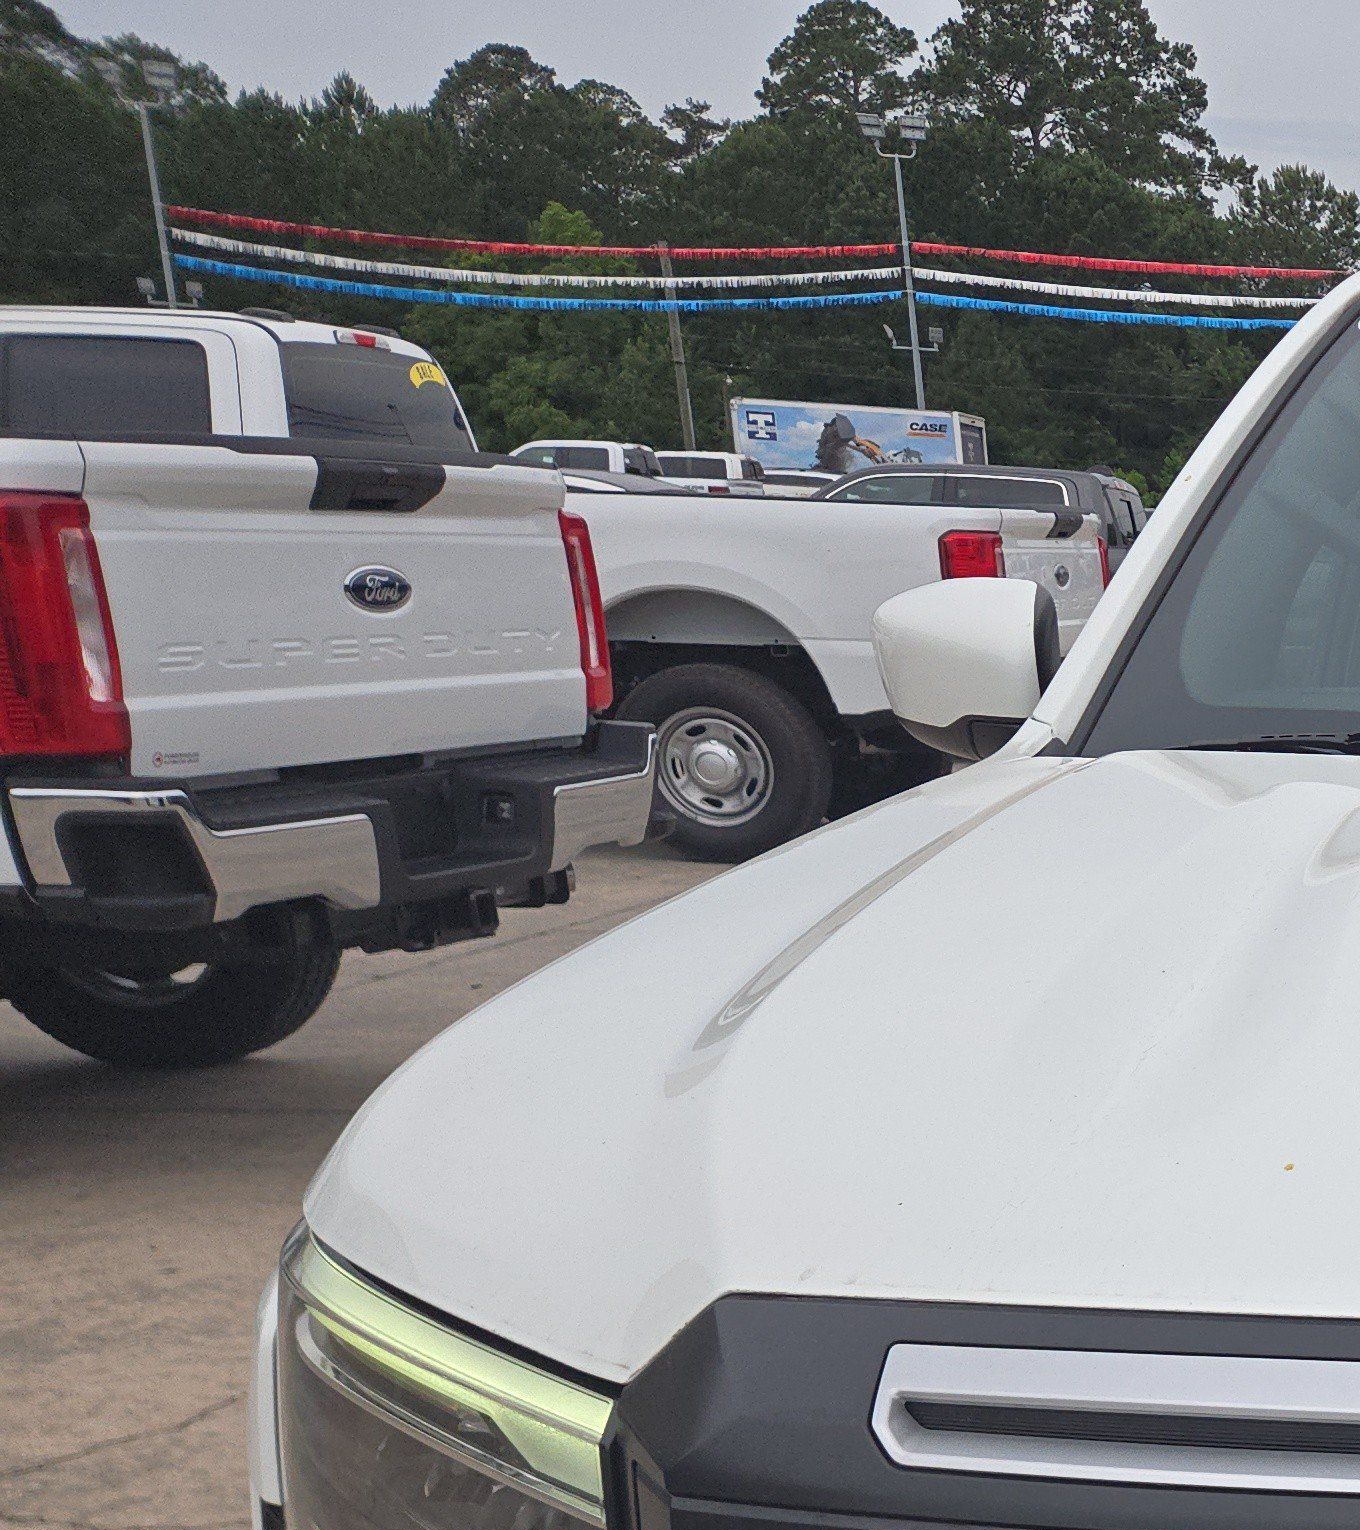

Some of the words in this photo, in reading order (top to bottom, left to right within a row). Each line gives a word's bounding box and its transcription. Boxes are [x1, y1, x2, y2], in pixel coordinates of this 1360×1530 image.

[909, 422, 948, 433] CASE
[364, 575, 400, 600] Ford
[158, 634, 406, 672] SUPER
[424, 631, 560, 657] DUTY
